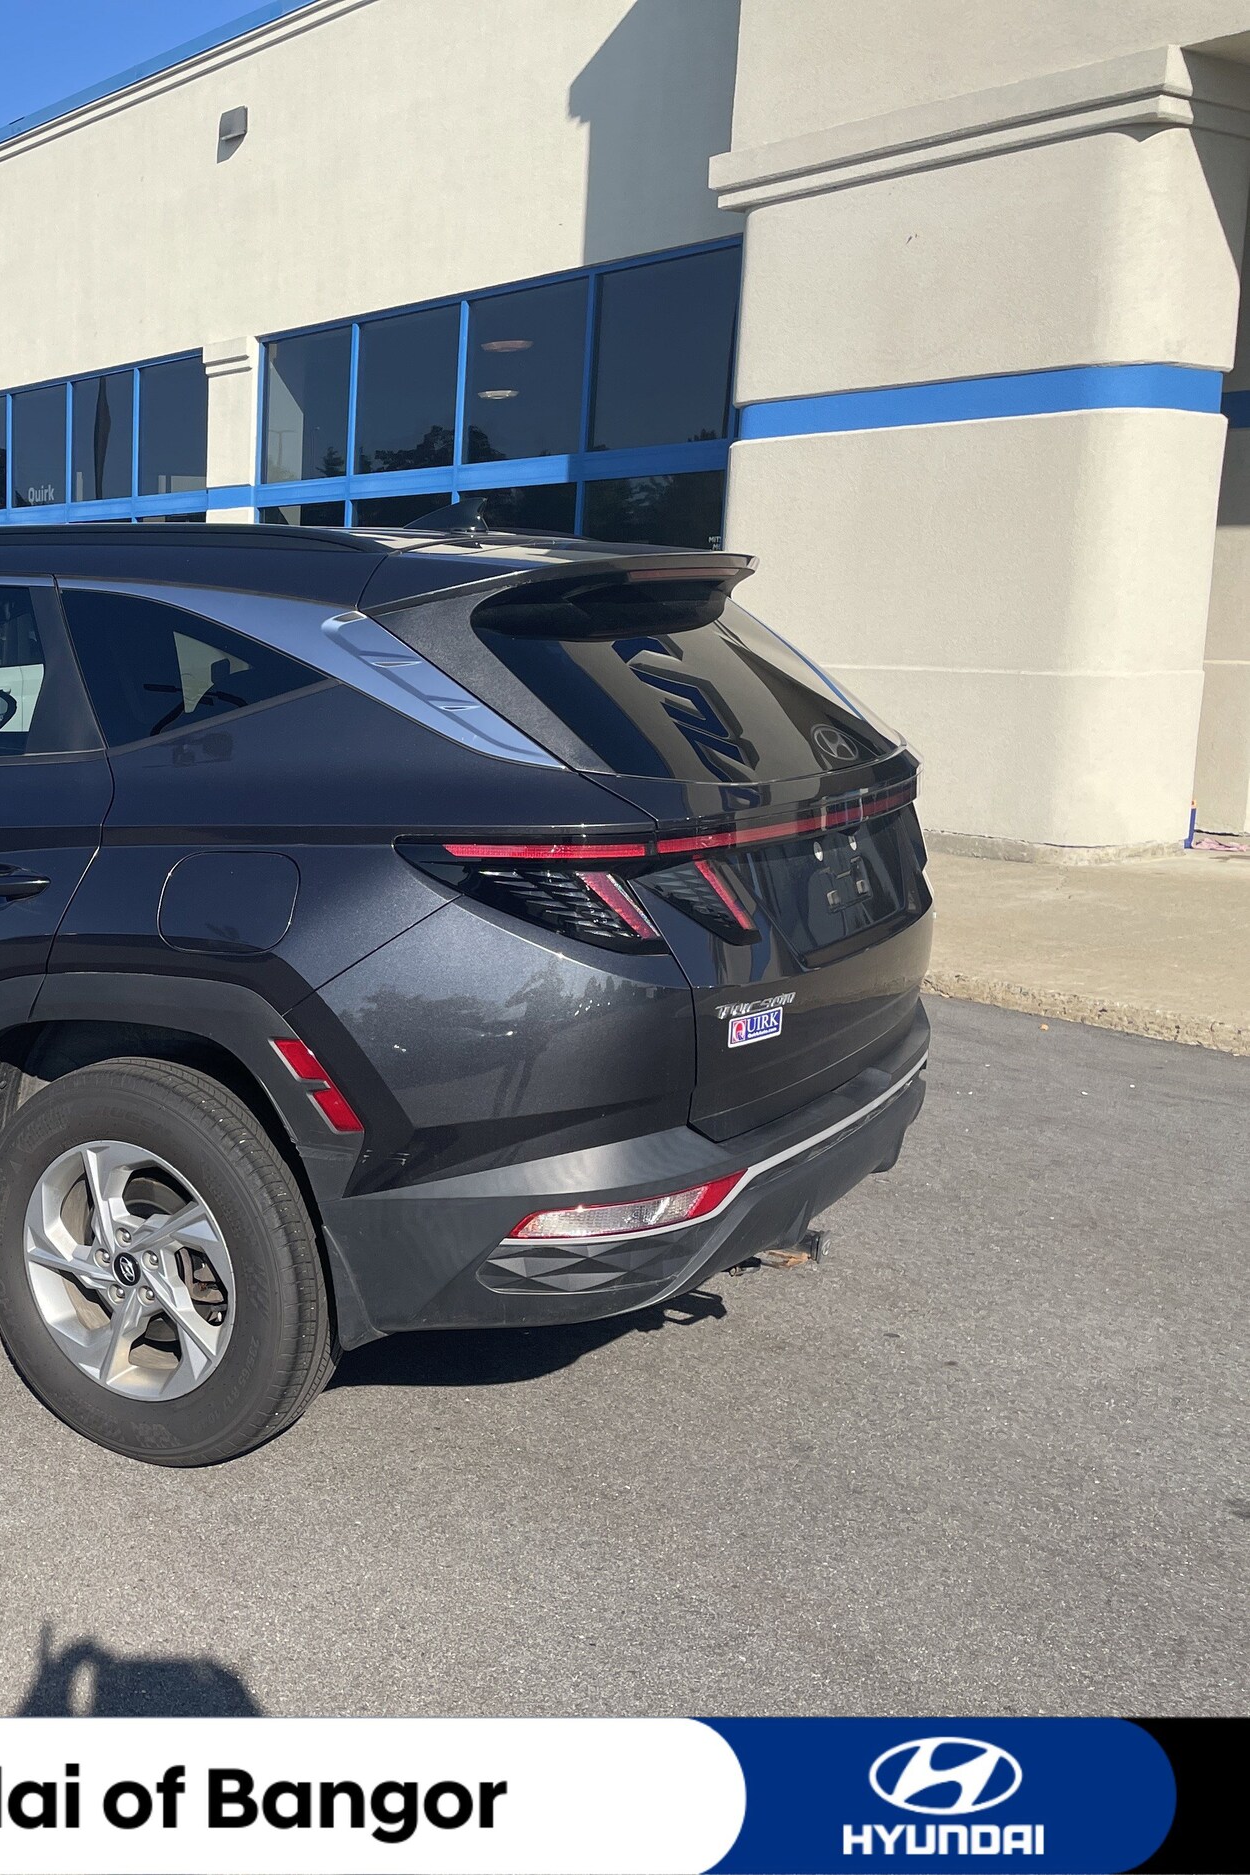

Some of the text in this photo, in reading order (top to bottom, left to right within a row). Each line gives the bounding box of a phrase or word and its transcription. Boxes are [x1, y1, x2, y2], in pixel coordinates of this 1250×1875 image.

[28, 484, 55, 505] Quirk
[715, 992, 796, 1020] TUCSON
[733, 1012, 779, 1042] QUIRK
